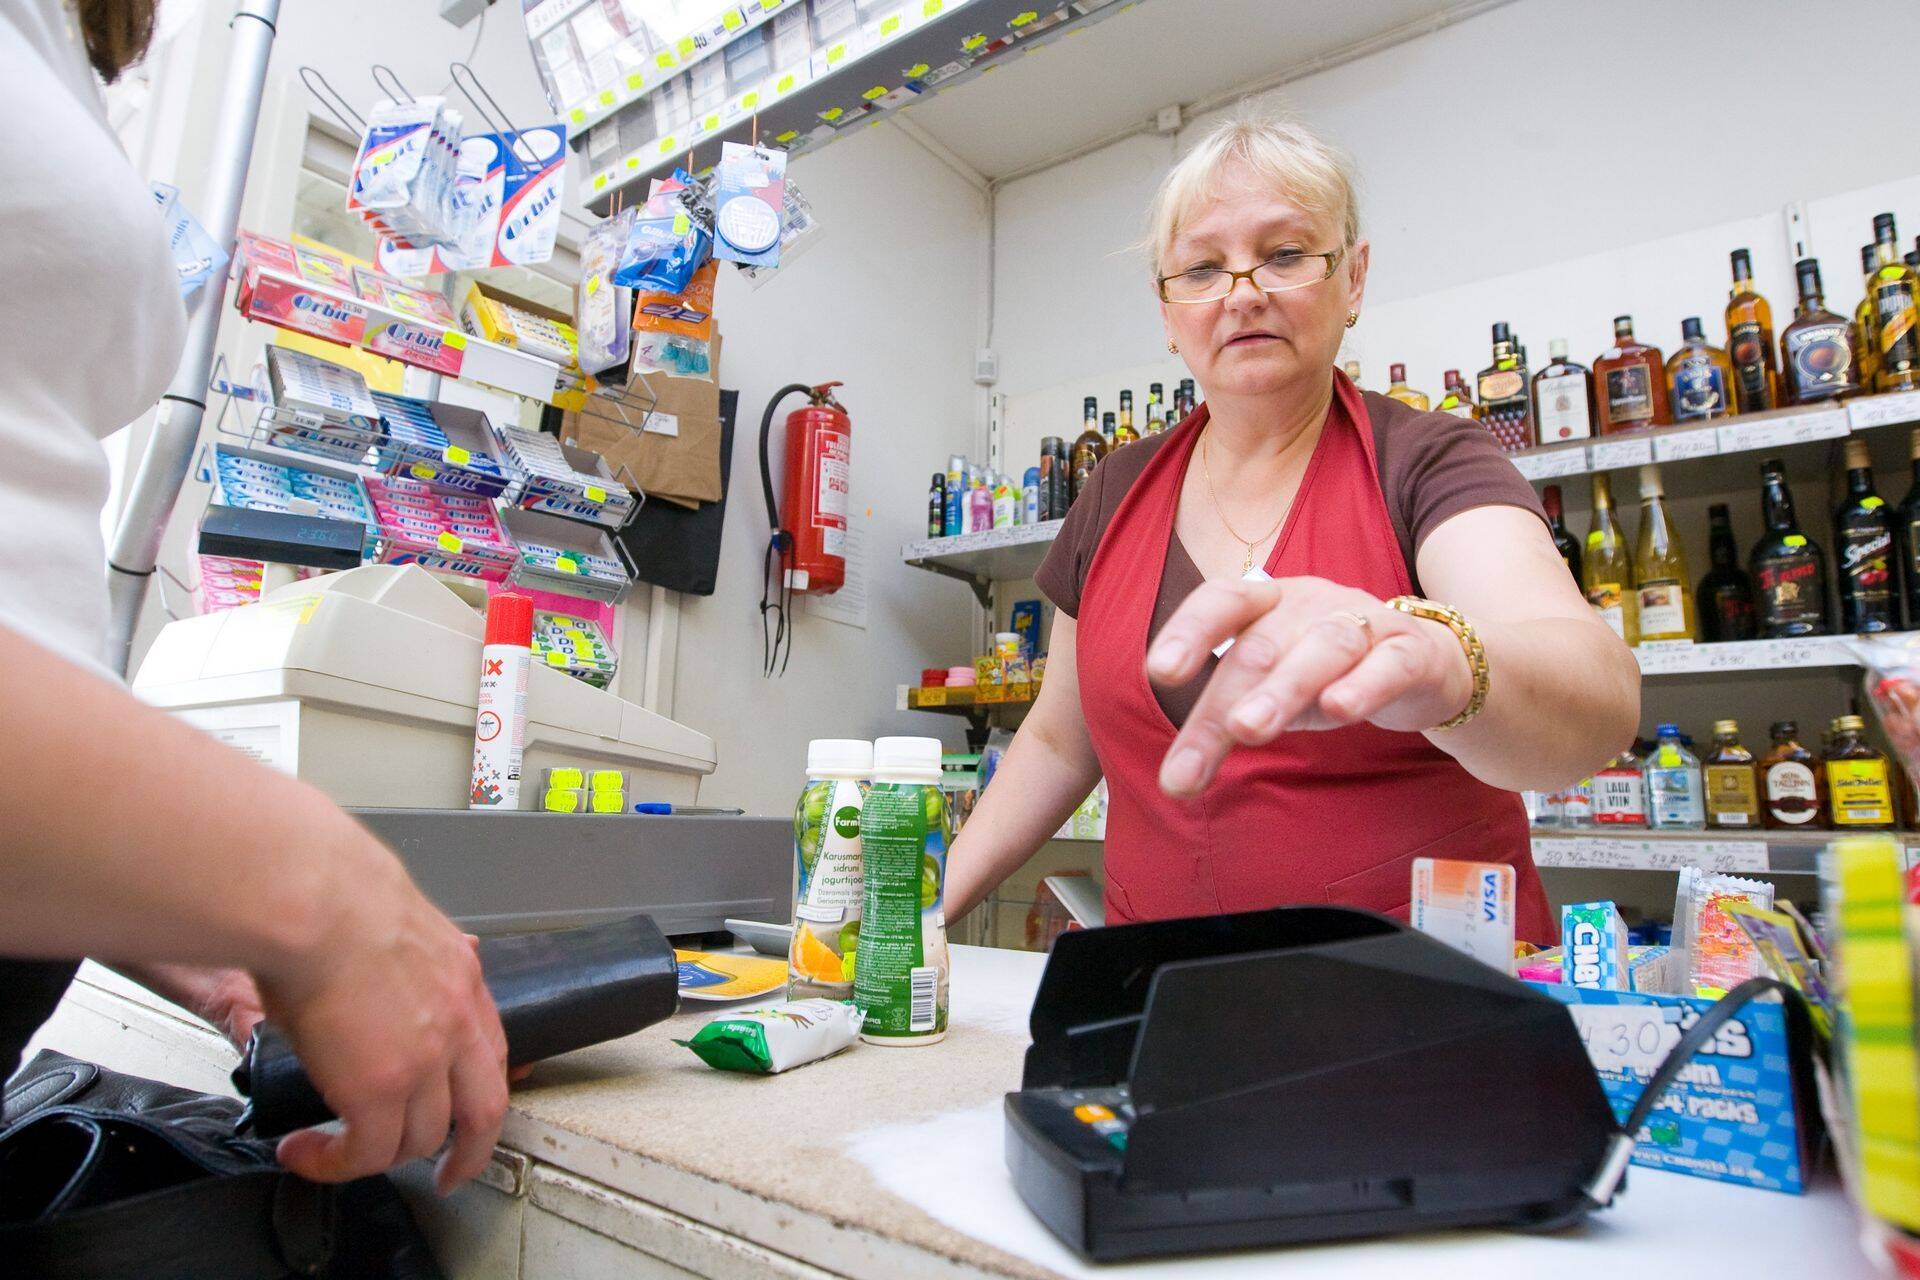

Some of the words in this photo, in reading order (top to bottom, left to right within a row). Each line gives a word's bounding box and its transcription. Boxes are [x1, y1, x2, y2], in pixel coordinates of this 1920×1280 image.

[505, 186, 557, 241] Orbit
[292, 293, 350, 323] Orbit
[386, 321, 443, 351] Orbit
[453, 523, 490, 535] Orbit
[1606, 781, 1631, 794] LAUA
[1608, 795, 1630, 807] VIIN
[823, 851, 863, 863] Karusmarj
[833, 863, 860, 872] sidruni
[822, 875, 863, 886] jogurtijoo
[1484, 873, 1497, 921] VISA
